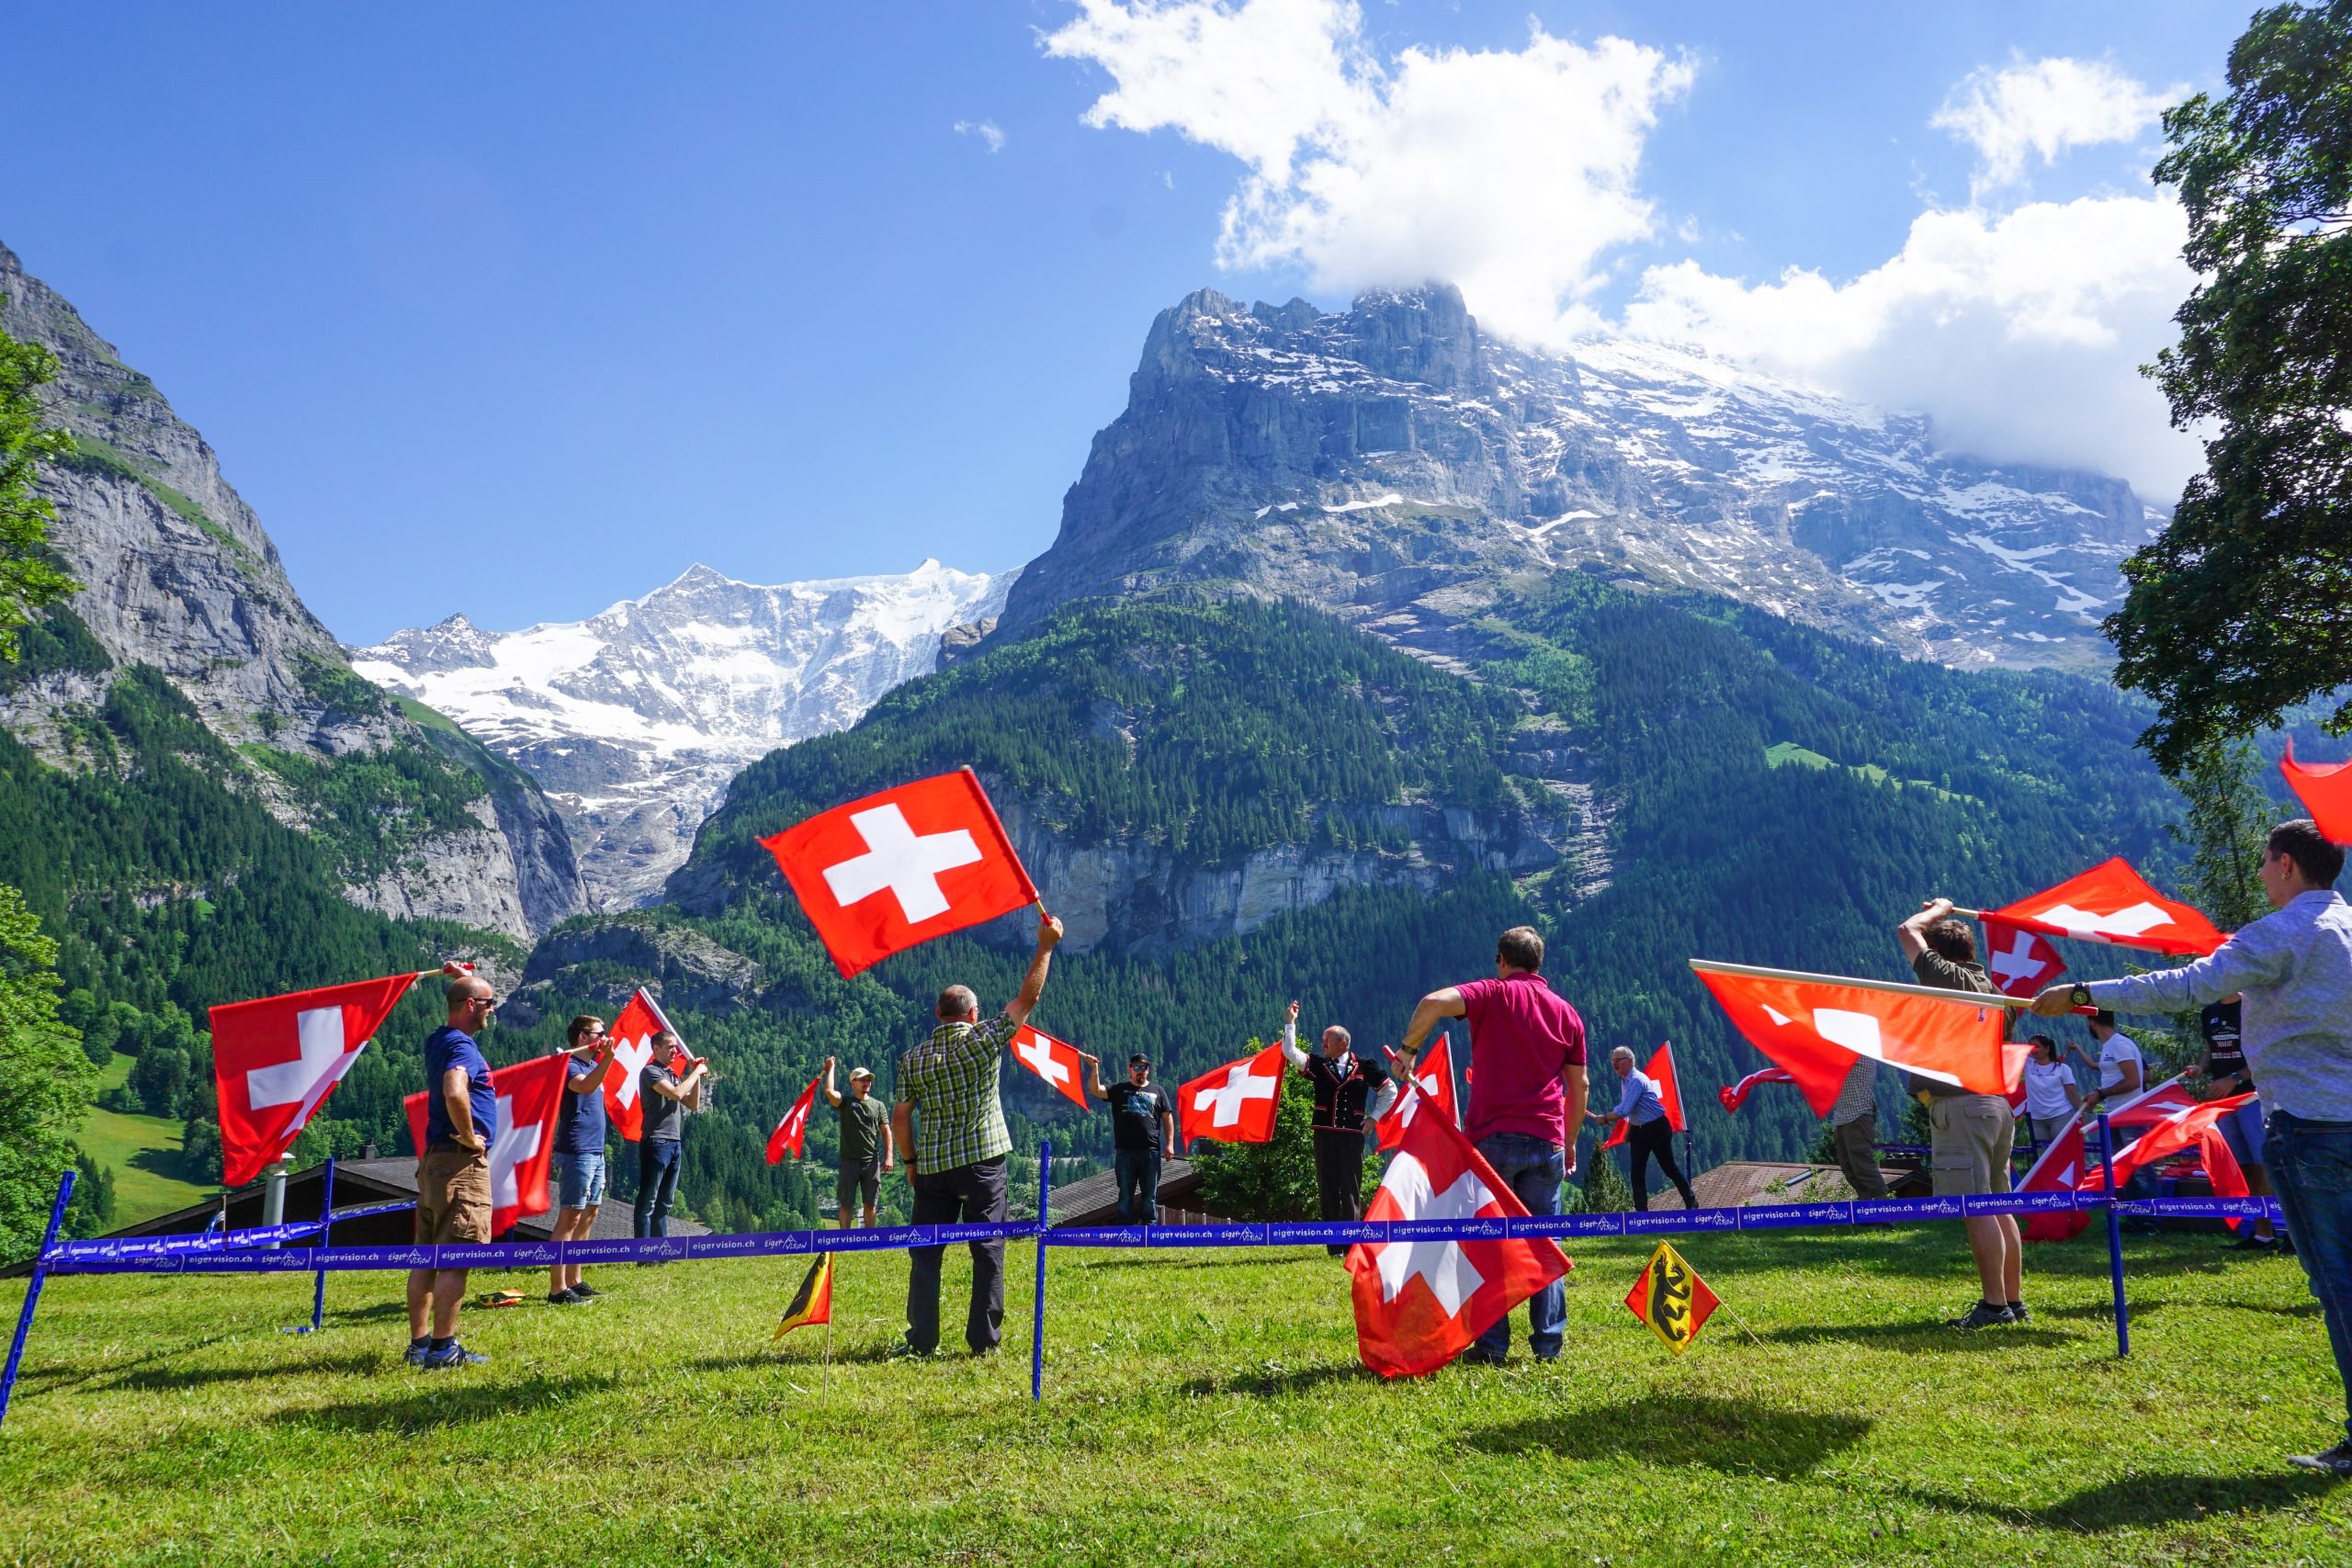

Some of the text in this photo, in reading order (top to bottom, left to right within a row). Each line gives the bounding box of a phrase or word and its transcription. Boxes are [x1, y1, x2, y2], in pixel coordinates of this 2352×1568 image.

[1968, 1198, 2024, 1209] eigervision.ch
[2159, 1202, 2215, 1211] eigervision.ch
[1857, 1204, 1913, 1215] eigervision.ch
[1629, 1215, 1687, 1226] eigervision.ch
[1744, 1210, 1801, 1221] eigervision.ch
[1394, 1225, 1453, 1235] eigervision.ch
[1512, 1221, 1571, 1231] eigervision.ch
[942, 1229, 1003, 1239] eigervision.ch
[1152, 1230, 1213, 1240] eigervision.ch
[1273, 1228, 1333, 1238] eigervision.ch
[818, 1235, 879, 1245] eigervision.ch
[693, 1240, 755, 1251] eigervision.ch
[442, 1250, 504, 1260] eigervision.ch
[568, 1246, 630, 1256] eigervision.ch
[189, 1255, 253, 1265] eigervision.ch
[316, 1253, 379, 1263] eigervision.ch
